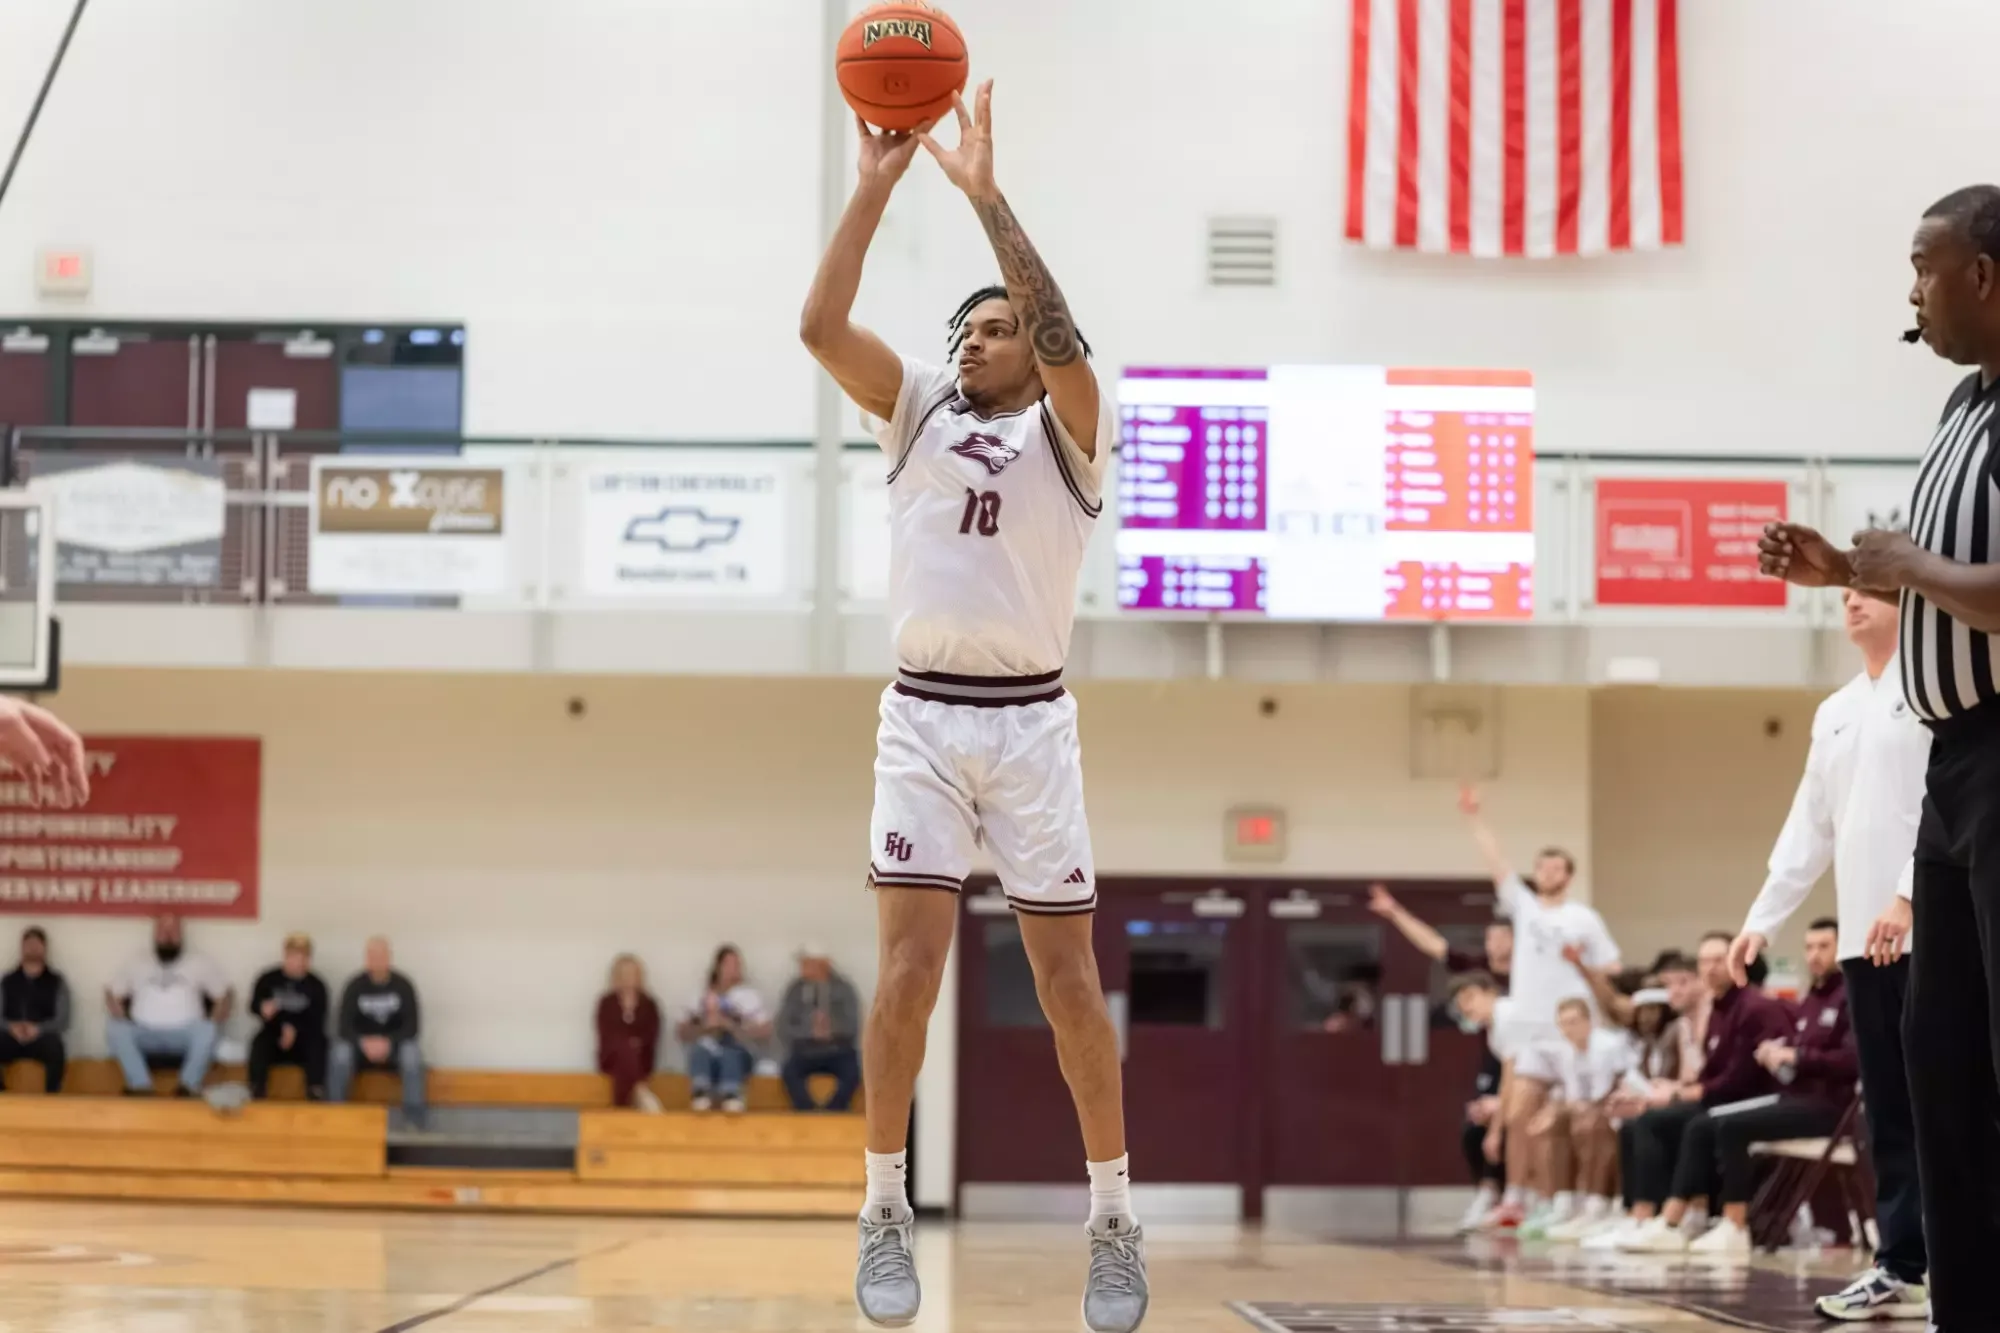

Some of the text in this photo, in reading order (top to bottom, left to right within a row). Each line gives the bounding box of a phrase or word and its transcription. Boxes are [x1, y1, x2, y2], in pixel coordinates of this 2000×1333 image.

[863, 18, 933, 52] NAIA
[958, 486, 1002, 537] 10
[0, 813, 178, 841] ESPONSIBILITY
[885, 832, 914, 862] FHU
